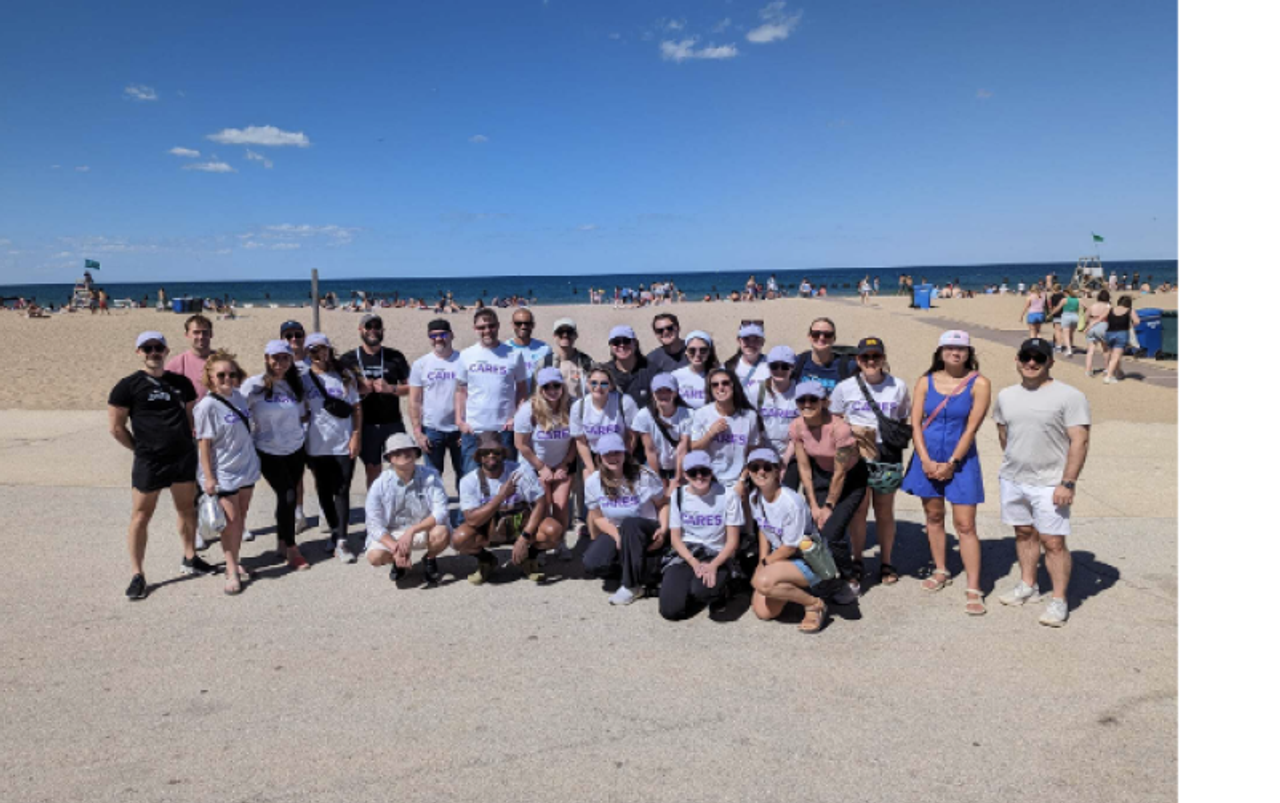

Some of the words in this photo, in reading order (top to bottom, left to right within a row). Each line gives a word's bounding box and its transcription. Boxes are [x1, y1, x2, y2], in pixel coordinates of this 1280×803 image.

[468, 362, 507, 376] CARES
[713, 432, 746, 446] ARES
[681, 512, 723, 527] CARES
